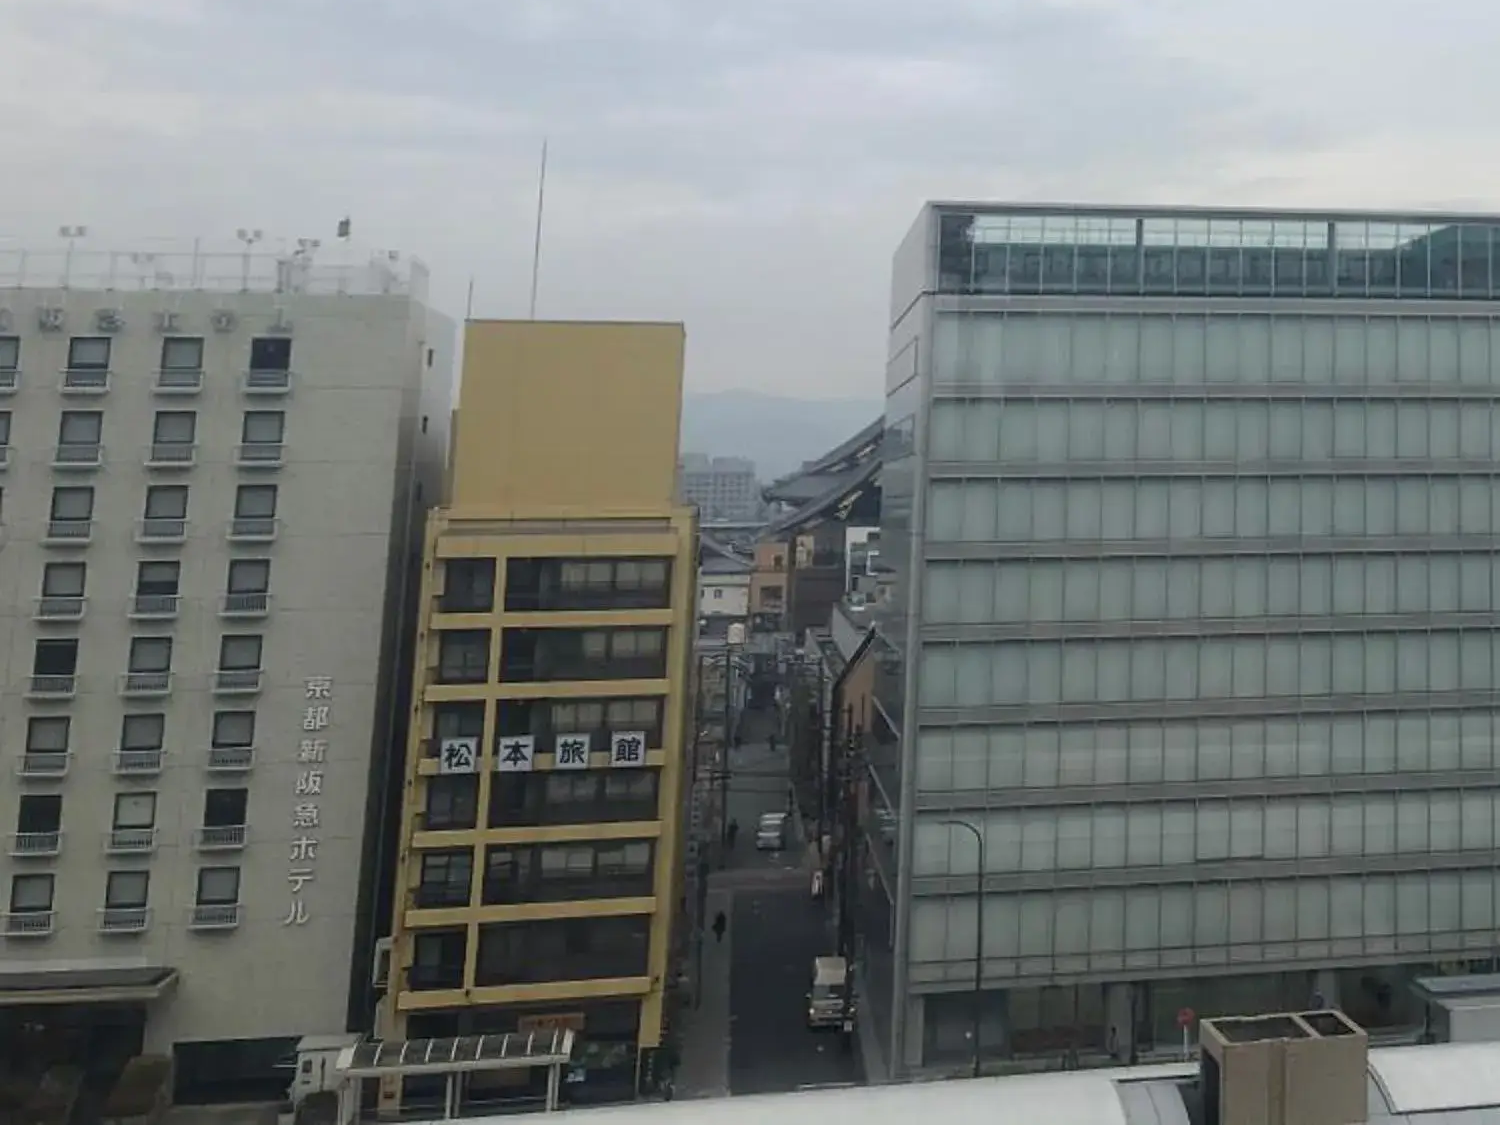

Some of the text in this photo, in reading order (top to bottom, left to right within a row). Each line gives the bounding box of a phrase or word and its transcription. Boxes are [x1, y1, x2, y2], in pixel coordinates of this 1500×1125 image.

[285, 675, 334, 925] 京都新阪急ホテル
[444, 737, 642, 770] 松本旅館
